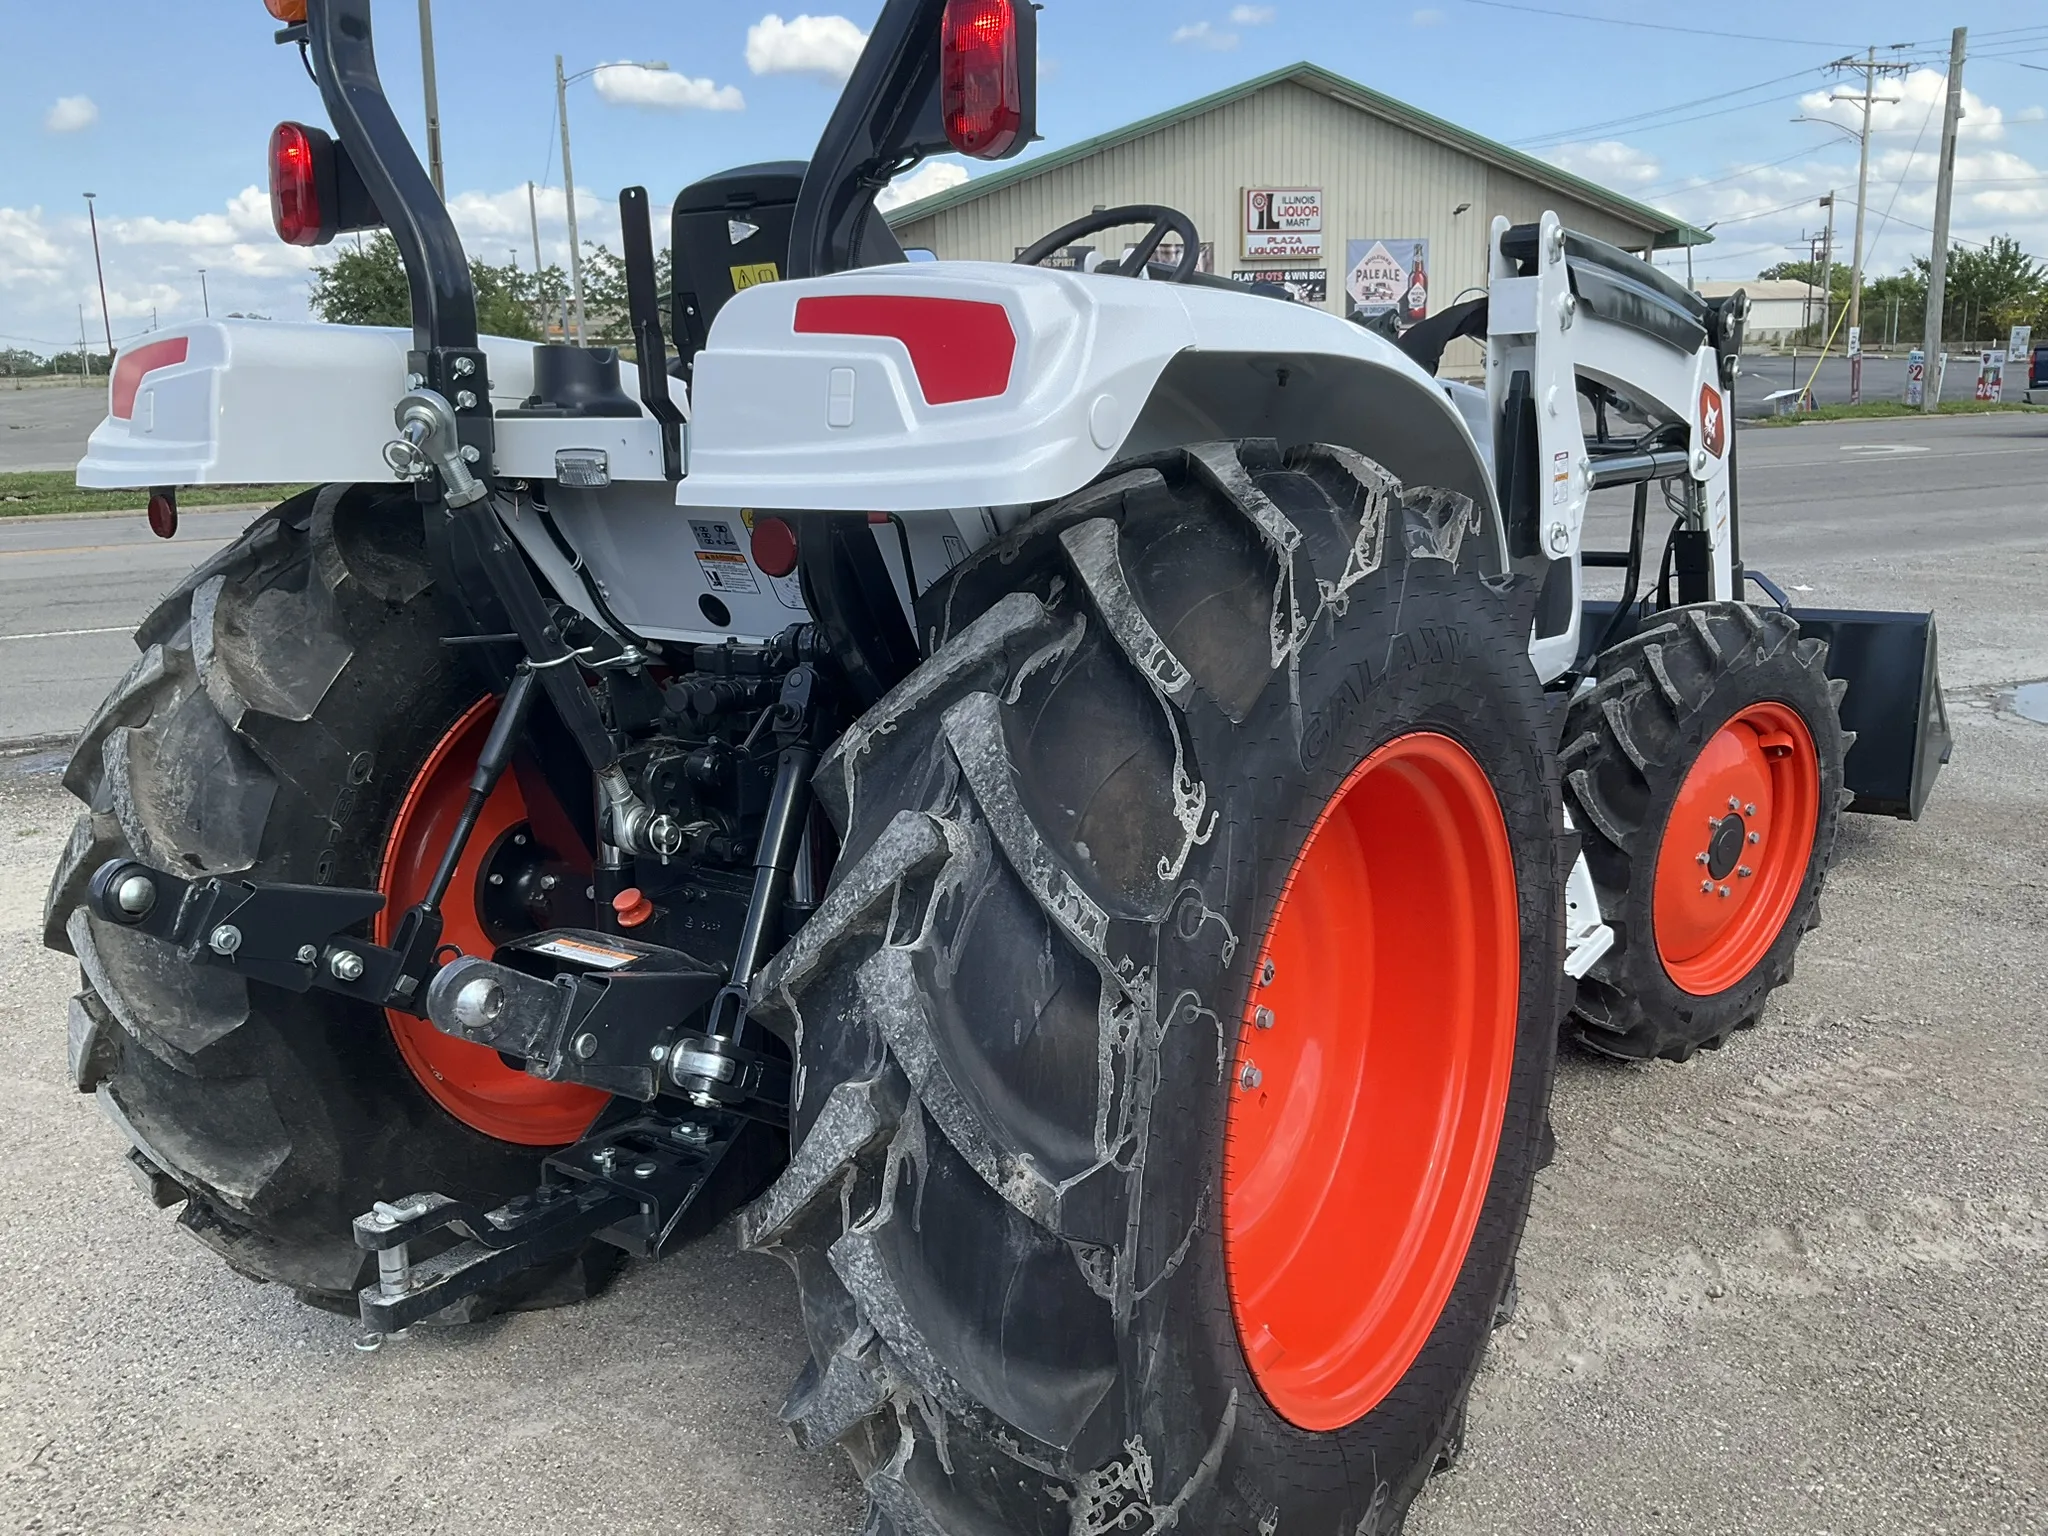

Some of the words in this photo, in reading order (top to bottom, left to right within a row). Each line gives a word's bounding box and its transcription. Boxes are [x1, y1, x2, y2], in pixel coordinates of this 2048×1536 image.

[1282, 196, 1315, 204] ILLINOIS
[1277, 206, 1319, 217] LIQUOR
[1286, 218, 1310, 226] MART
[1249, 246, 1287, 254] LIQUOR
[1290, 246, 1320, 254] MART
[1052, 258, 1076, 267] SPIRIT
[1233, 273, 1255, 281] PLAY
[1255, 272, 1283, 281] SLOTS
[1284, 272, 1291, 280] &
[1291, 272, 1308, 280] WIN
[1309, 271, 1325, 280] BIG!
[1356, 269, 1380, 283] PALE
[1382, 269, 1400, 282] ALE
